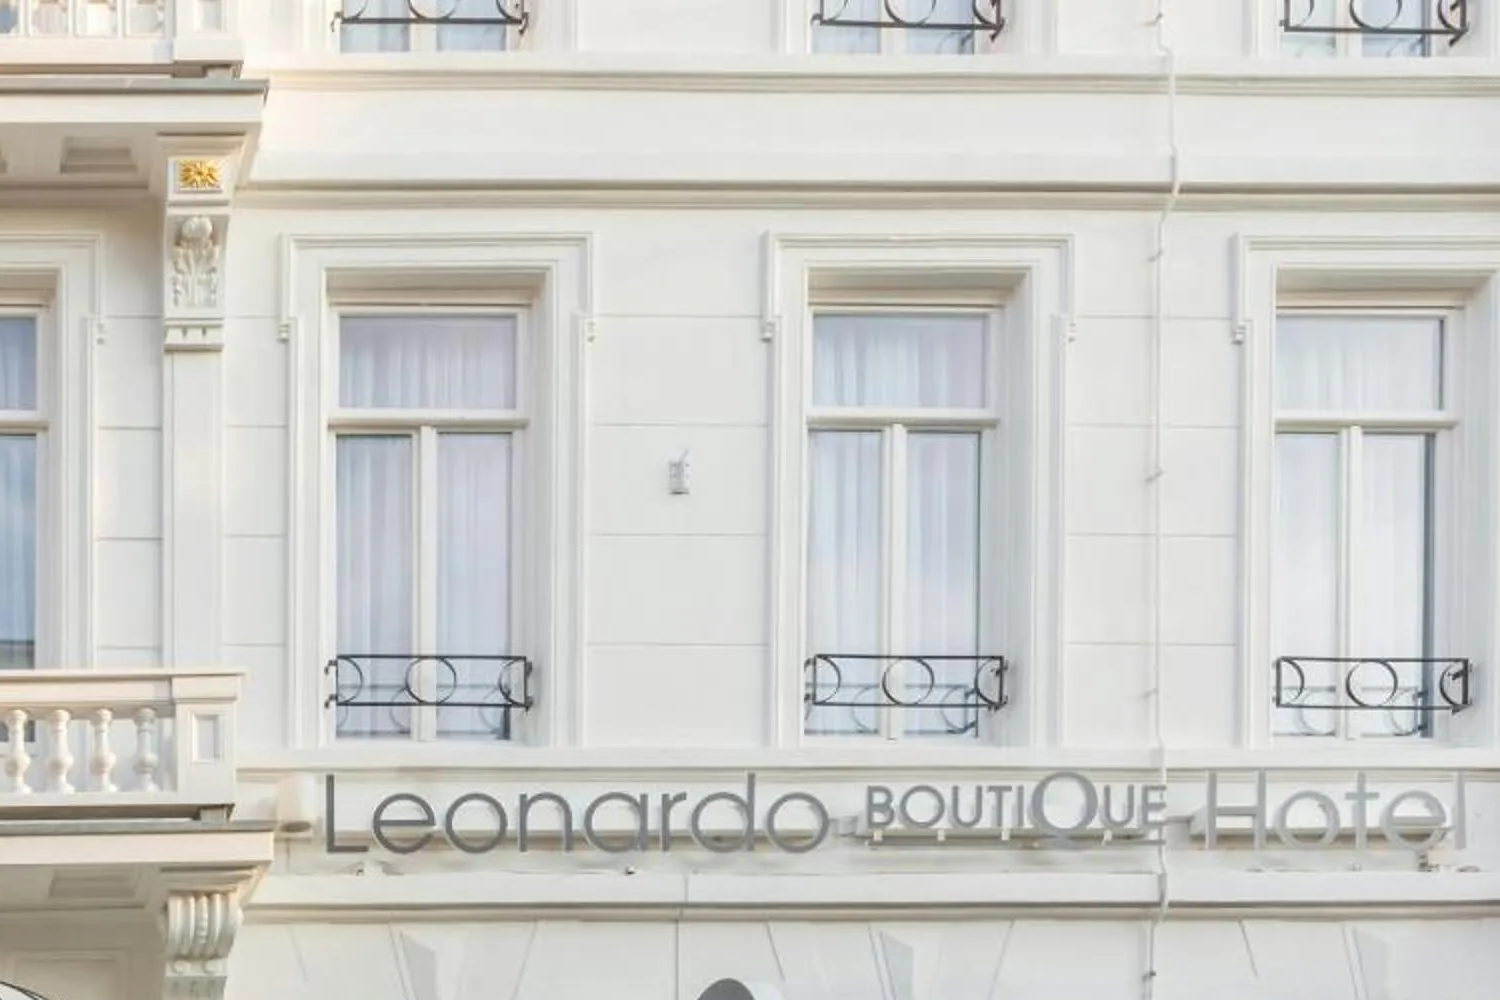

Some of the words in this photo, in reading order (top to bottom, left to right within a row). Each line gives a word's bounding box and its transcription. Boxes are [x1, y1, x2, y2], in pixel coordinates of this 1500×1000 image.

[325, 773, 830, 854] Leonardo
[865, 771, 1167, 850] BOUTIQUE
[1206, 770, 1467, 851] Hotel
